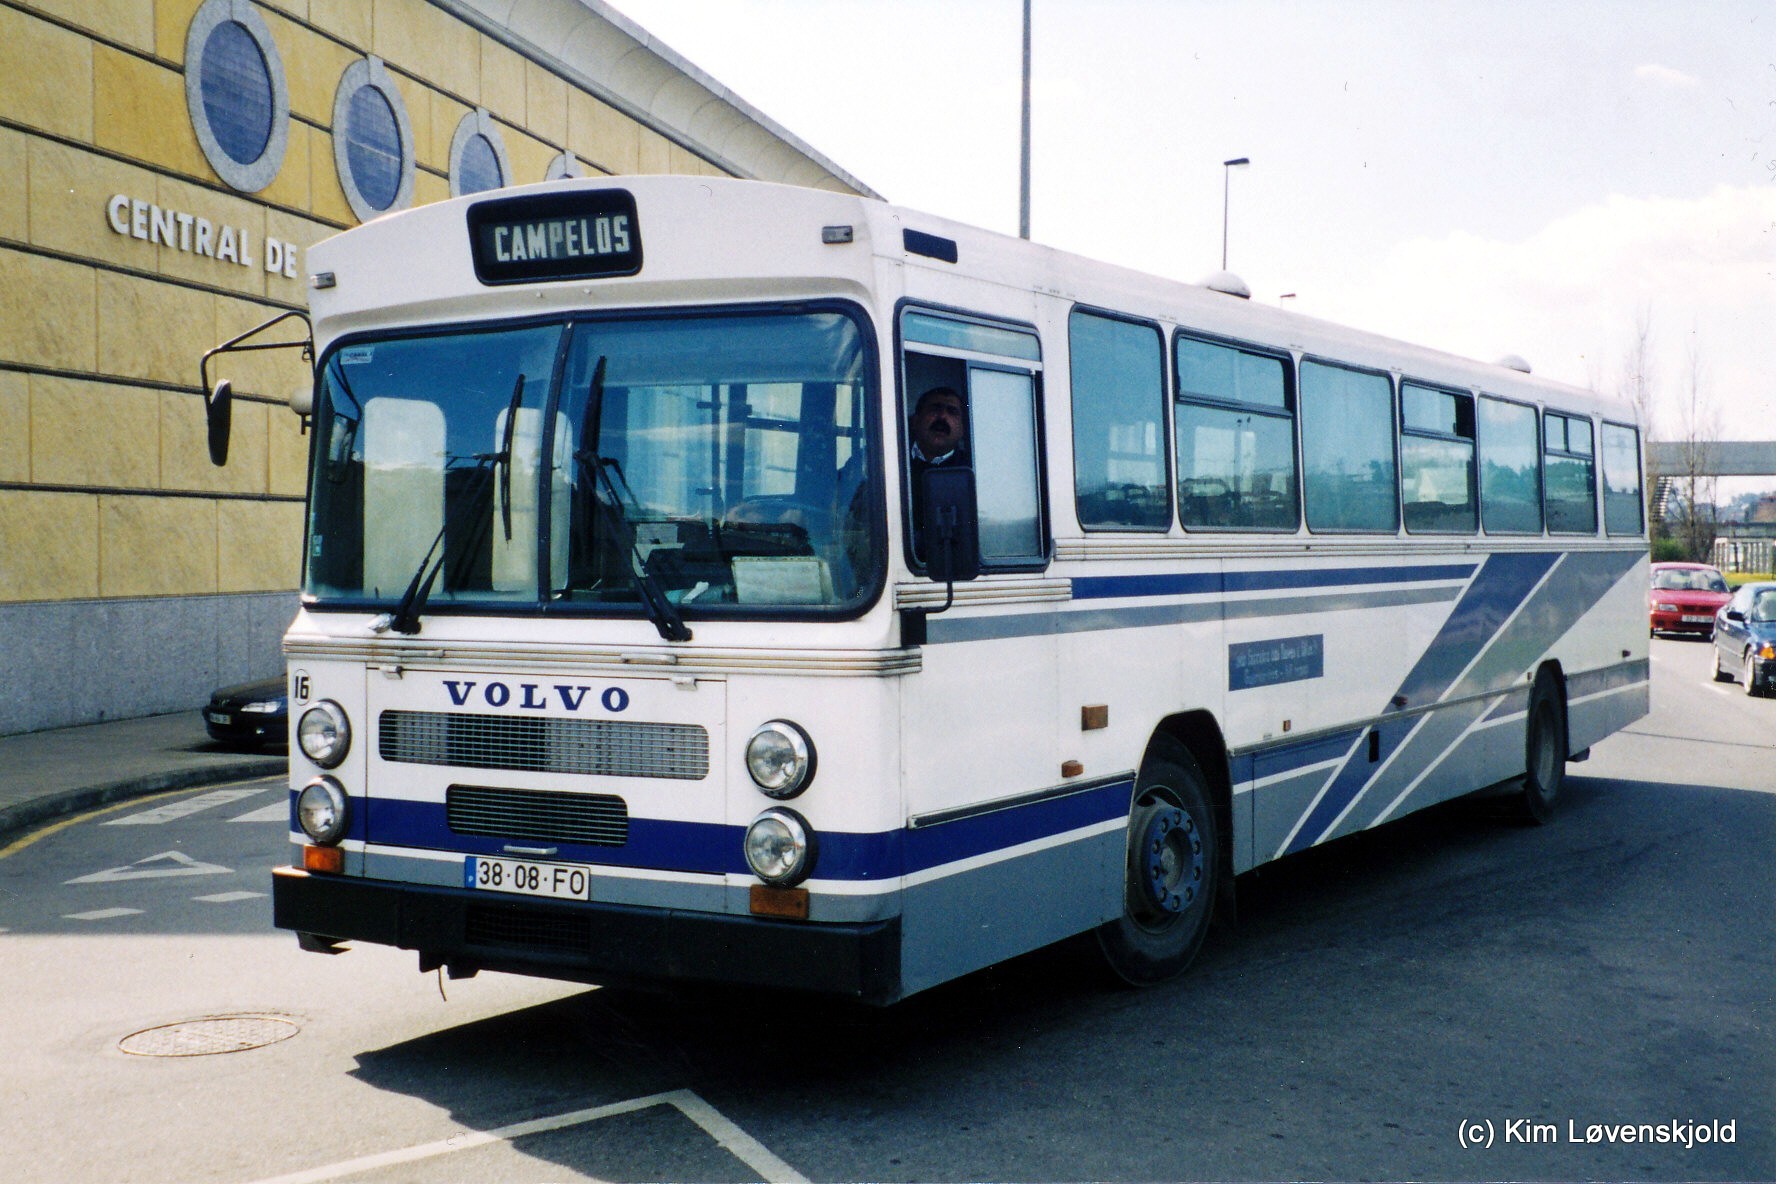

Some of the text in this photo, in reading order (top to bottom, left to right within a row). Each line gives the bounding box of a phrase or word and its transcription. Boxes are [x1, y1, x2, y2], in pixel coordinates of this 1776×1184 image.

[107, 194, 297, 279] CENTRAL DE
[494, 215, 631, 262] CAMPELOS
[295, 675, 310, 699] 16
[442, 680, 630, 713] VOLVO
